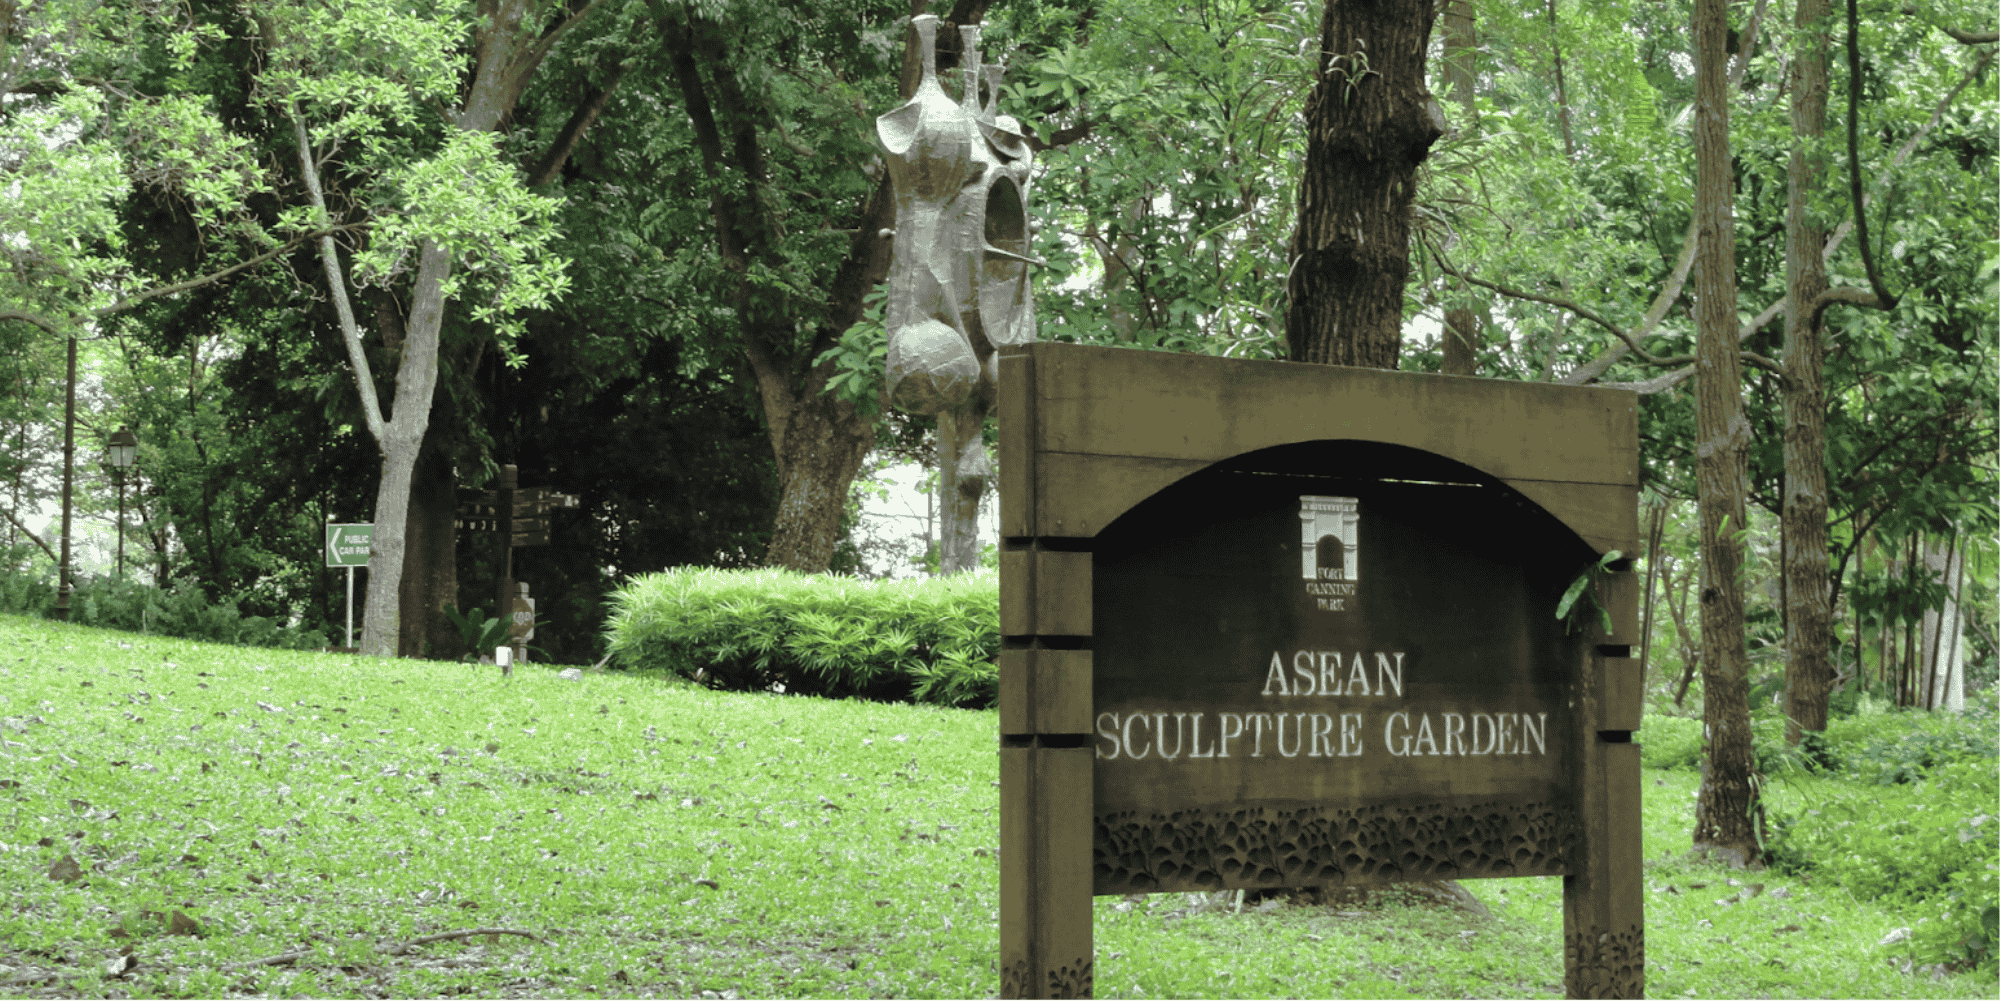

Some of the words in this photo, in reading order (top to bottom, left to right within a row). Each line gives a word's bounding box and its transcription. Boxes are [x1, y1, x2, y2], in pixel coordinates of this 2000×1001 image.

[344, 535, 369, 544] PUBLIC
[339, 546, 354, 555] CAR
[355, 546, 370, 554] PAR
[1317, 567, 1343, 579] FORT
[1306, 583, 1355, 595] CANNING
[1317, 598, 1344, 610] PARK
[1261, 650, 1405, 697] ASEAN
[1096, 711, 1363, 760] SCULPTURE
[1384, 711, 1547, 757] GARDEN
